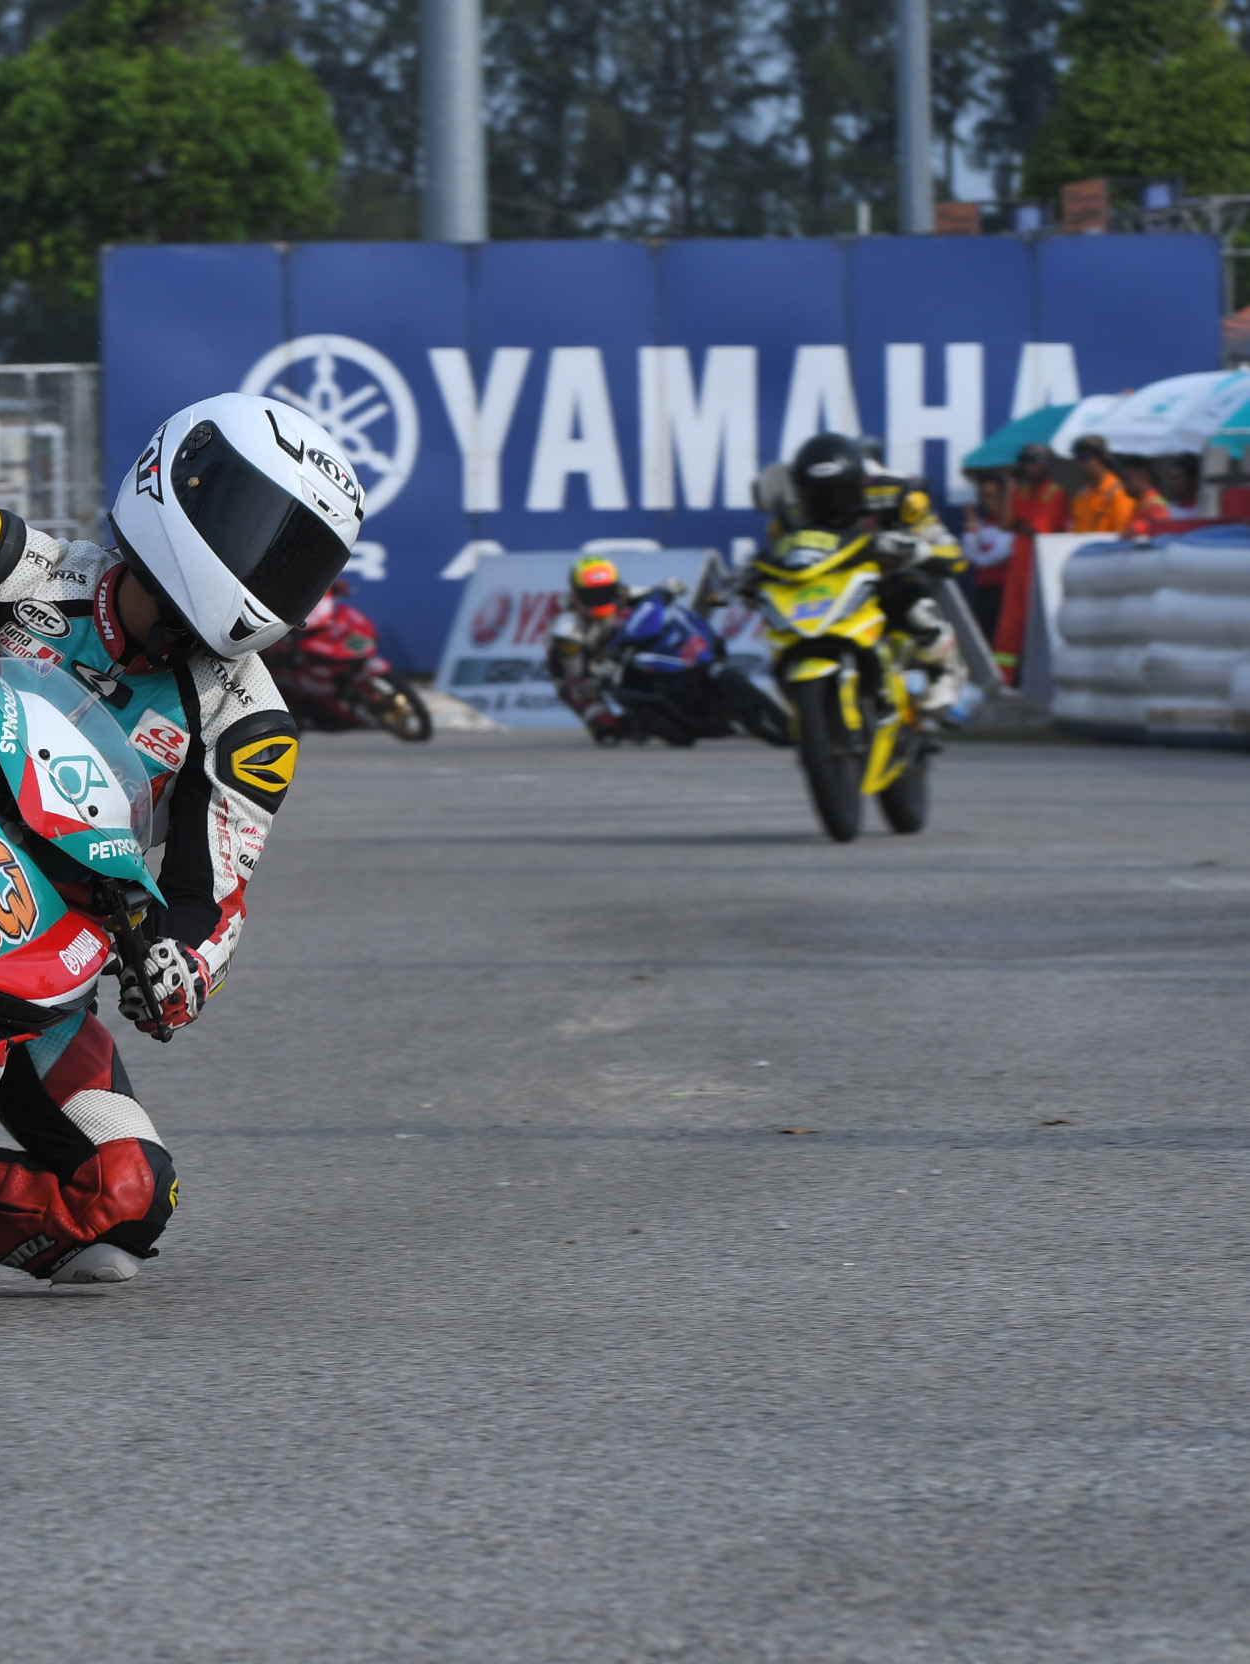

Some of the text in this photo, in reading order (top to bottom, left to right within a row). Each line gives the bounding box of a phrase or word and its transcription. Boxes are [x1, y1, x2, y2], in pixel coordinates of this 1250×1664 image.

[20, 604, 61, 630] ARC
[99, 577, 115, 641] TAICHI
[3, 624, 32, 647] uma
[134, 732, 181, 766] RCB
[65, 927, 103, 968] YAMAHA
